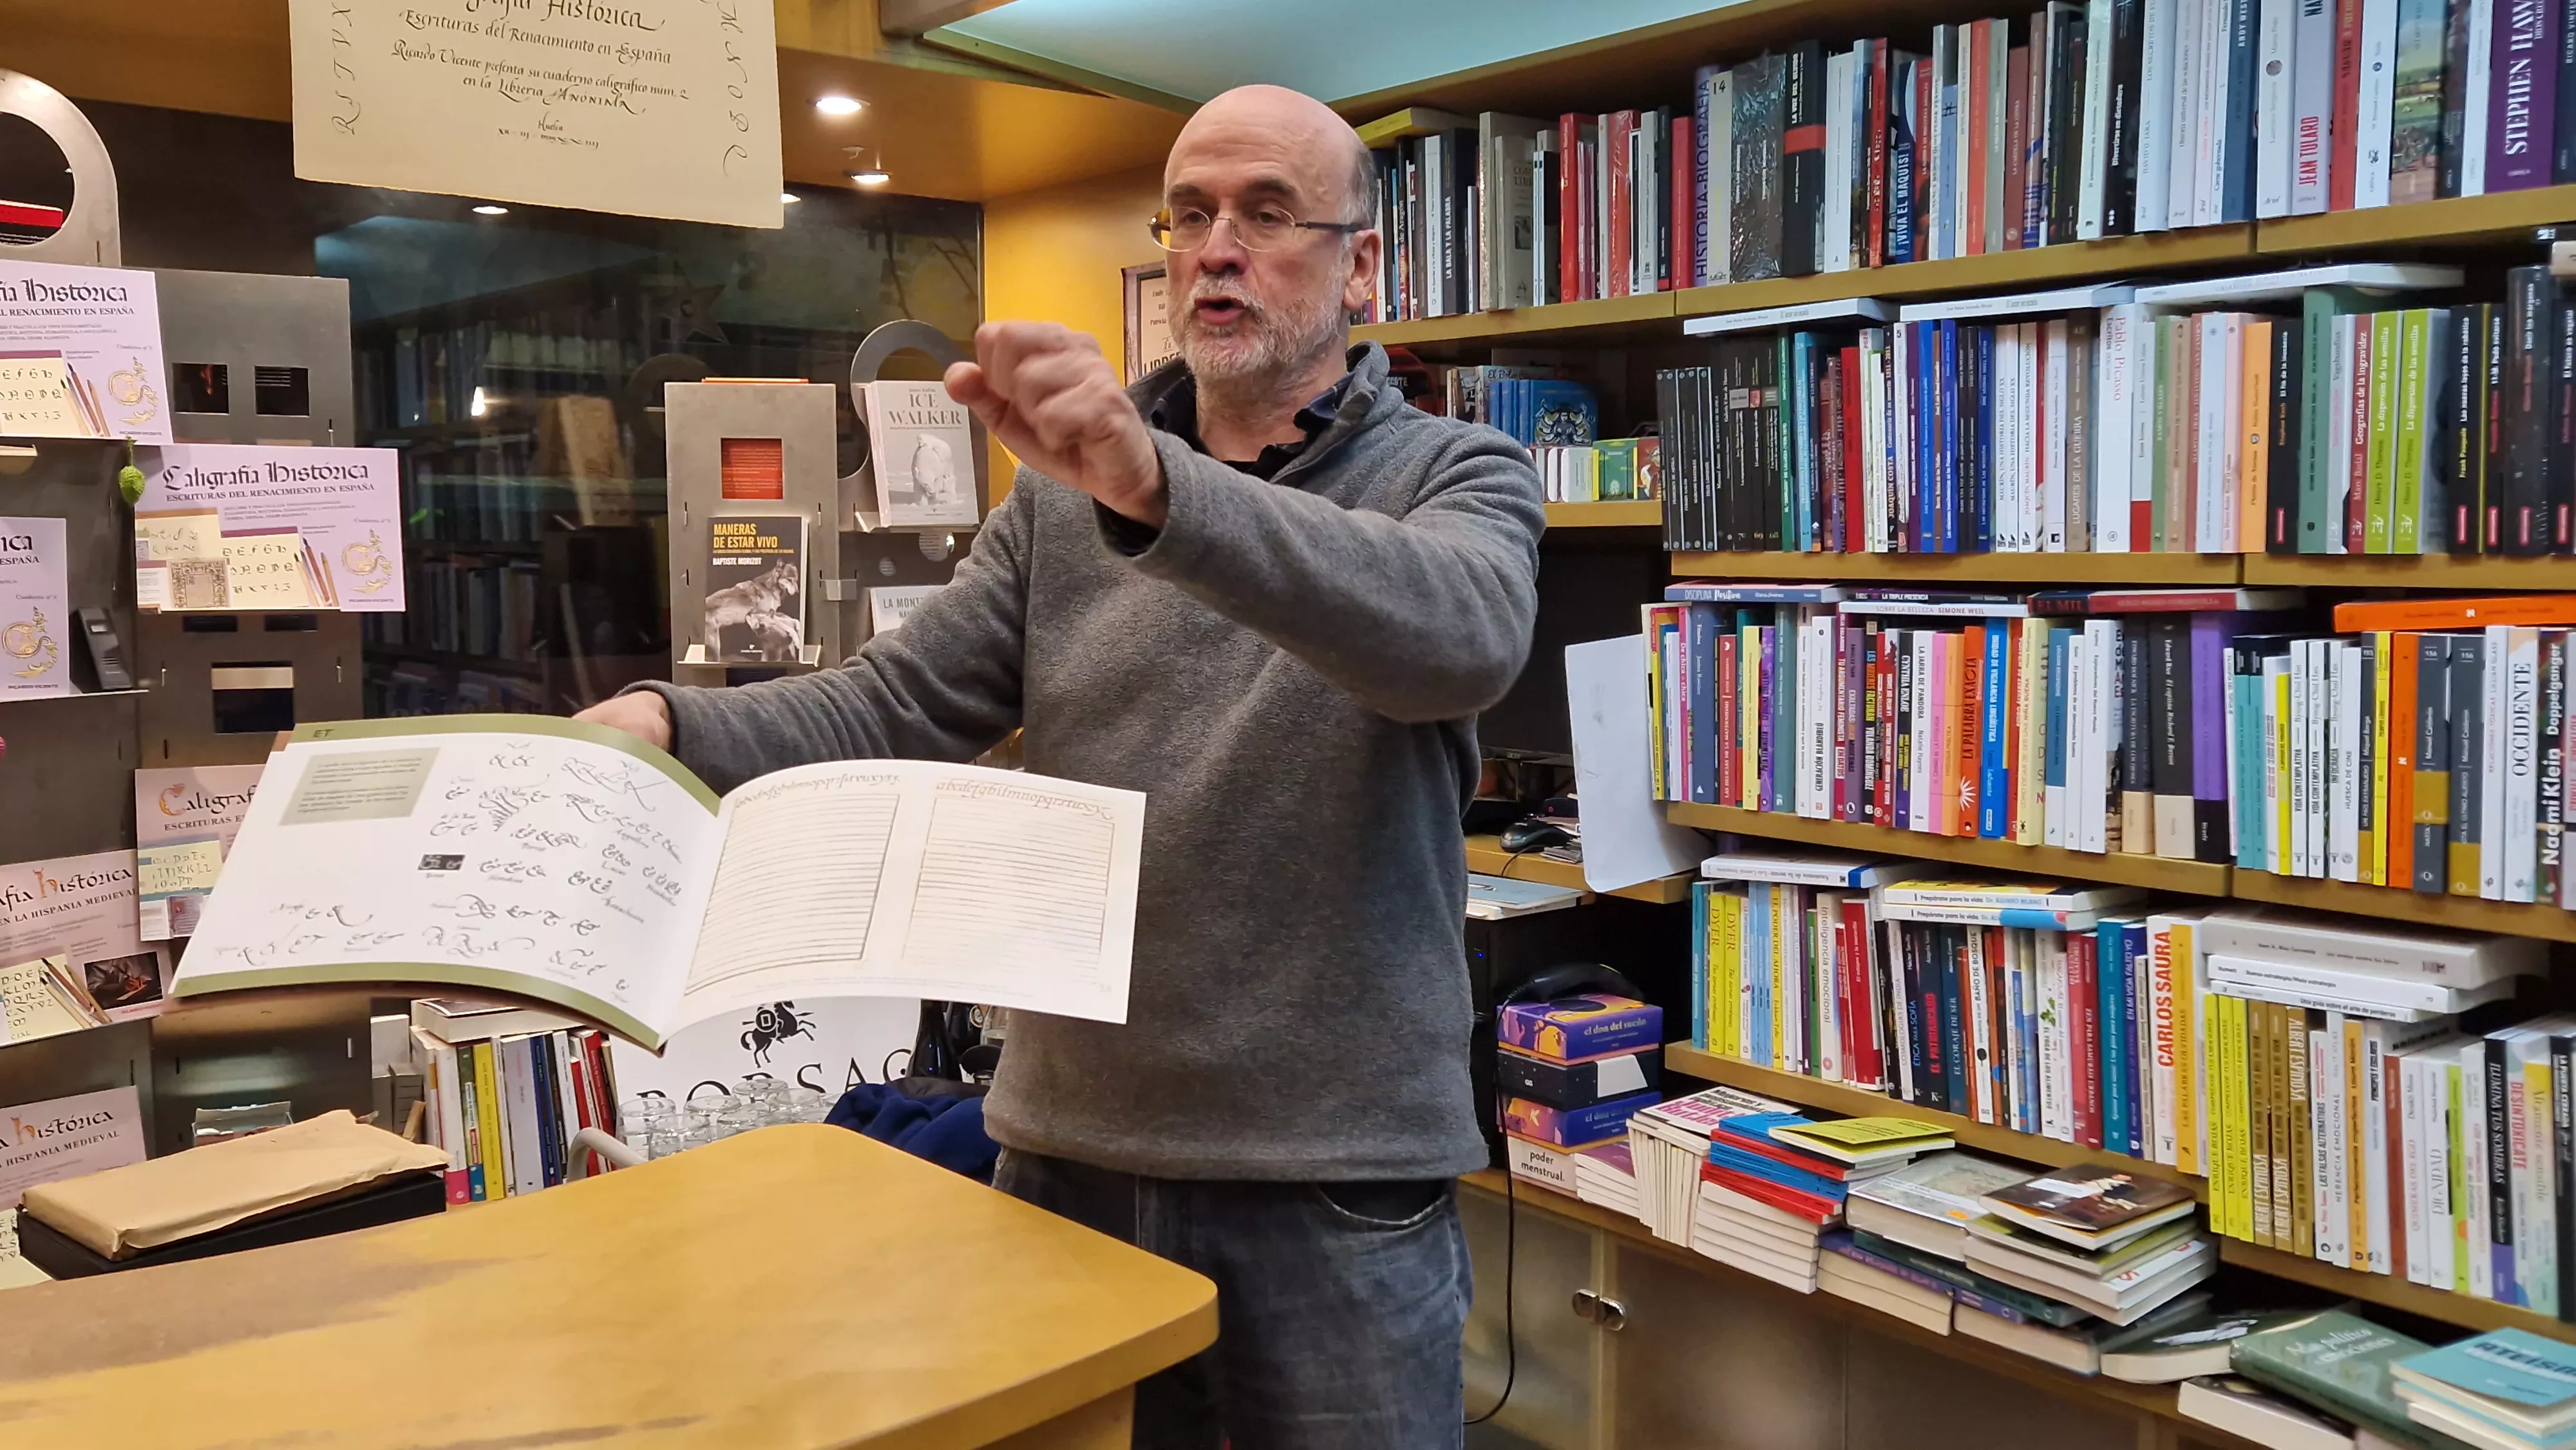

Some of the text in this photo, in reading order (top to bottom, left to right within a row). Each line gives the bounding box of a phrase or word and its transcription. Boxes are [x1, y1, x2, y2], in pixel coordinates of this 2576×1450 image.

[399, 10, 479, 33] Escrituras
[484, 19, 505, 39] del
[508, 27, 594, 53] Renacimiento
[597, 43, 611, 55] en
[615, 42, 672, 66] España
[391, 39, 435, 61] Ricardo
[440, 49, 482, 69] Vicente
[528, 68, 540, 78] su
[543, 67, 593, 86] cuaderno
[2505, 0, 2535, 155] STEPHEN HAW
[463, 77, 477, 87] en
[480, 76, 491, 89] la
[2298, 116, 2319, 187] JEAN TULARD
[1896, 154, 1909, 245] ¡VIVA EL MAQUIS!
[20, 278, 128, 303] Histórica
[10, 308, 80, 317] RENACIMIENTO
[99, 306, 135, 315] ESPAÑA
[2113, 317, 2126, 401] Pablo Picasso
[909, 393, 938, 408] ICE
[2353, 332, 2368, 501] Marc Badal Geografías de la ingravidez
[889, 411, 961, 425] WALKER
[162, 461, 369, 491] Caligrafía Histórica
[2072, 416, 2082, 524] LUGARES DE LA GUERRA
[166, 482, 375, 502] ESCRITURAS DEL RENACIMIENTO EN ESPAÑA
[714, 523, 757, 535] MANERAS
[714, 536, 778, 548] DE ESTAR VIVO
[883, 598, 923, 608] LA MONT
[1685, 591, 1713, 599] DISCIPLINA
[1875, 605, 1897, 614] SOBRE
[1968, 607, 1985, 615] WEIL
[1918, 646, 1925, 654] LA
[1918, 677, 1925, 686] DE
[1864, 651, 1876, 790] LAS MUJERES FACTURAN YOLANDA DOMÍNGUEZ
[1962, 657, 1977, 760] LA PALABRA EXACTA
[2512, 663, 2531, 777] OCCIDENTE
[312, 728, 334, 739] ET
[1814, 722, 1824, 791] GENERACIÓN BLANDIBLÚ
[2542, 643, 2562, 865] Naomi Klein Doppelganger
[2294, 748, 2303, 812] VIDA CONTEMPLATIVA
[2345, 767, 2352, 778] DE
[159, 784, 257, 816] Caligraf
[164, 816, 232, 831] ESCRITURAS
[15, 913, 28, 922] LA
[32, 901, 82, 919] HISPANIA
[1711, 909, 1719, 945] DYER
[1727, 912, 1736, 950] DYER
[1822, 907, 1832, 1023] Inteligencia emocional
[1969, 931, 1982, 1001] BAÑO DE BOSQUE
[1909, 1001, 1917, 1025] SOFÍA
[2154, 930, 2175, 1068] CARLOS SAURA
[1584, 1026, 1593, 1035] el
[1593, 1025, 1609, 1033] don
[1610, 1021, 1622, 1030] del
[1951, 1015, 1958, 1027] DE
[1911, 1042, 1920, 1066] ÉTICA
[1951, 1030, 1960, 1063] CORAJE
[2288, 1017, 2306, 1101] ALBERT ESPINOSA
[1953, 1065, 1960, 1075] EL
[2510, 1081, 2527, 1169] DESINTOXICATE
[6, 1131, 120, 1167] HISPANIA MEDIEVAL
[1529, 1151, 1555, 1167] poder
[2316, 1102, 2327, 1187] LAS FALSAS ALTERNATIVAS
[2332, 1094, 2342, 1202] HERENCIA EMOCIONAL
[1521, 1160, 1566, 1183] menstrual.
[2253, 1154, 2271, 1236] ALBERT ESPINOSA
